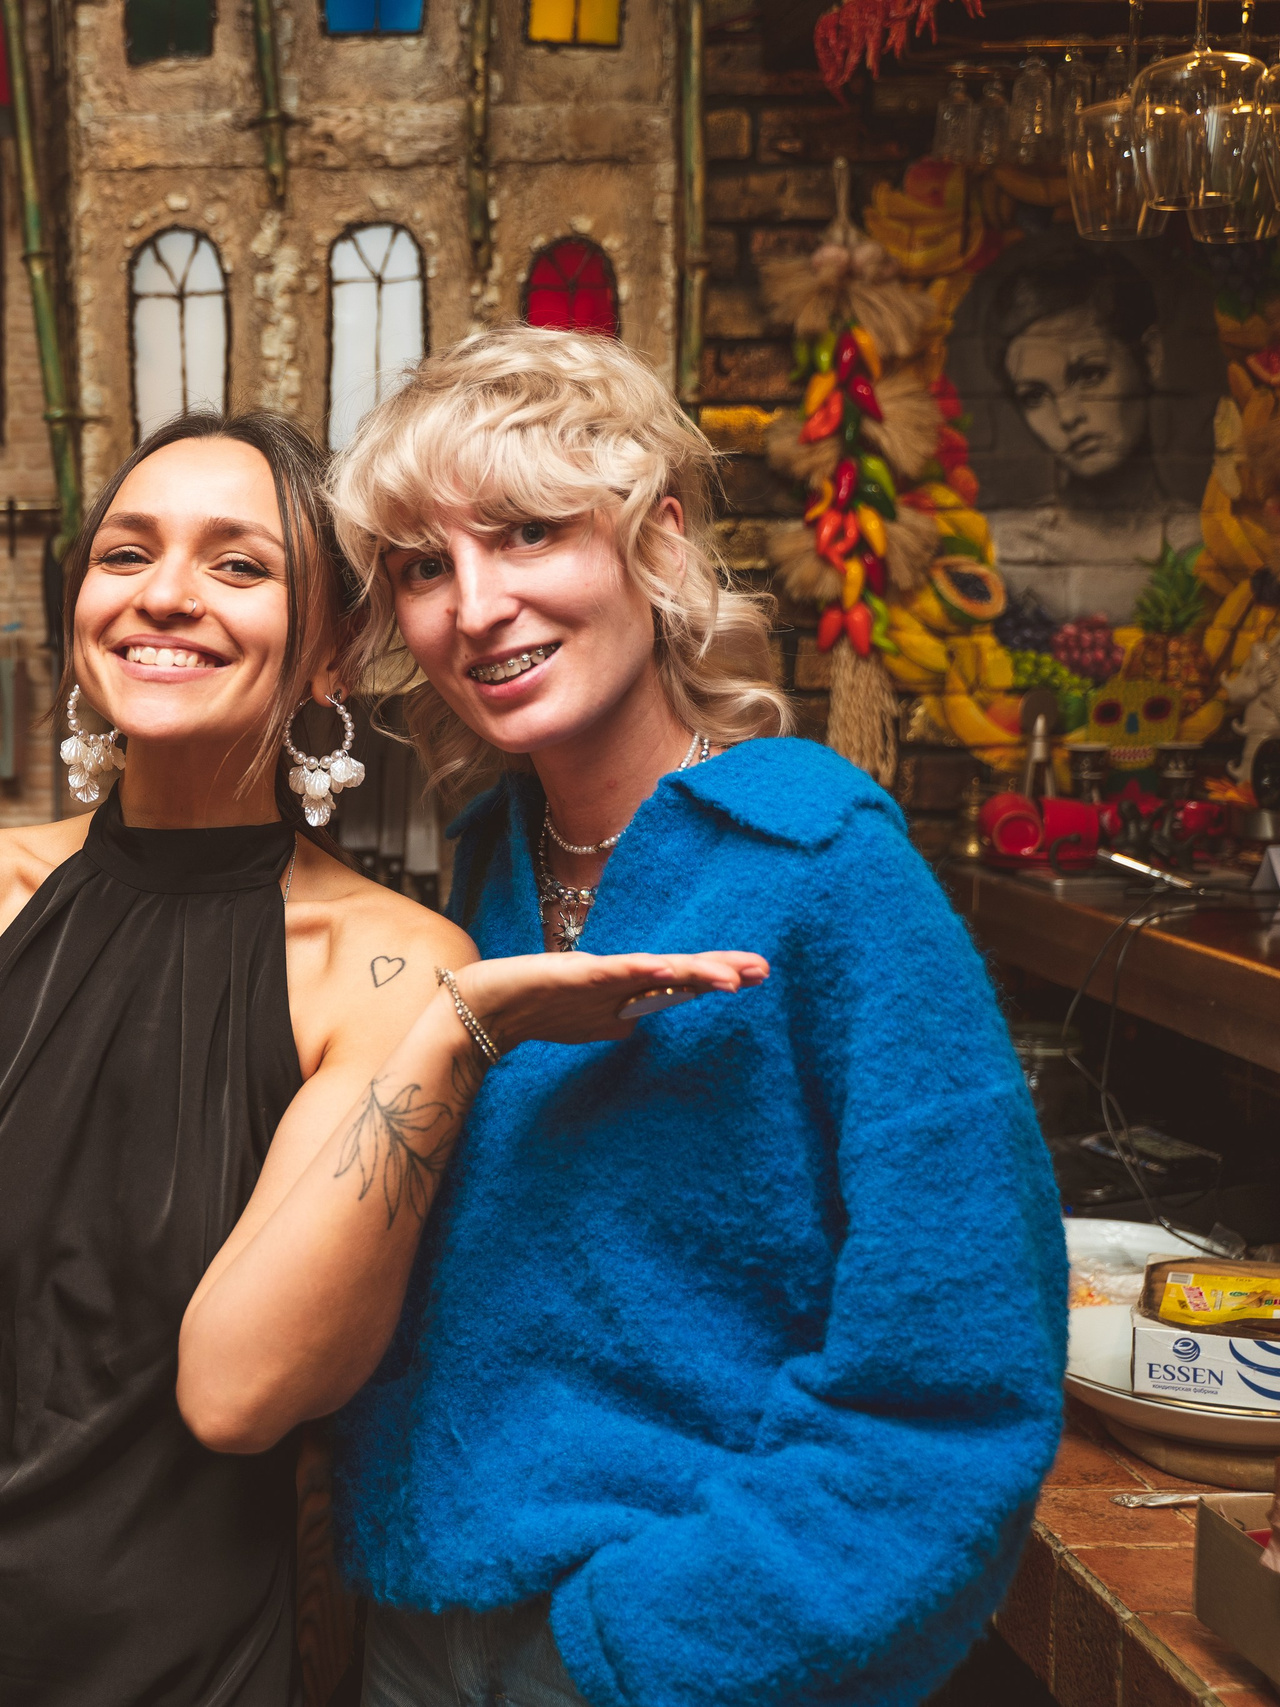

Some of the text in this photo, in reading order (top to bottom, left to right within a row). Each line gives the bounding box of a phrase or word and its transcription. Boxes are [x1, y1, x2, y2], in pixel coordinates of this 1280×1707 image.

[1147, 1363, 1223, 1386] ESSEN
[1152, 1384, 1218, 1395] кондитерская фабрика
